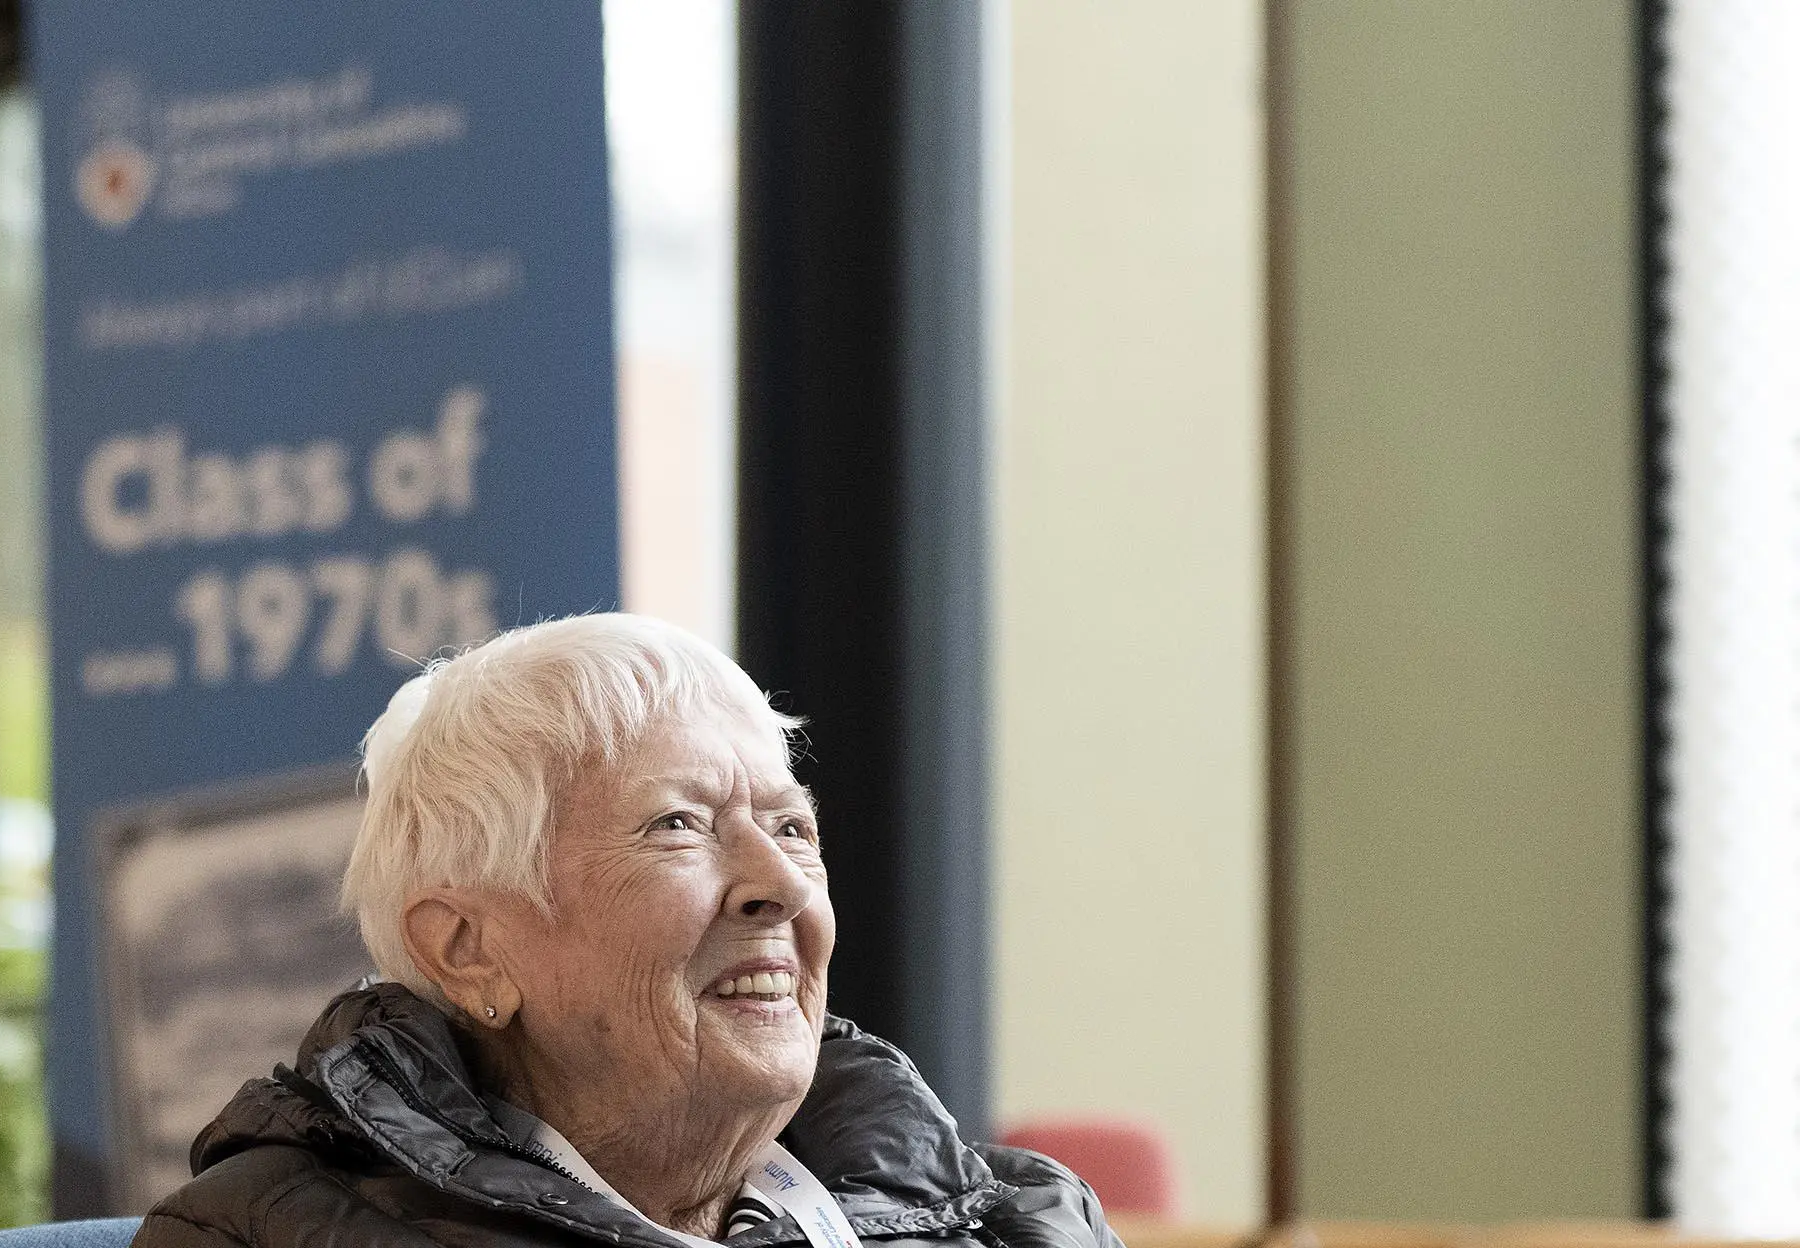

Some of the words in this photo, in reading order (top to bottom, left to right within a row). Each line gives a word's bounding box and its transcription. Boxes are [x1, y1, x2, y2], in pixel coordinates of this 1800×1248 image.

[81, 427, 352, 555] Class
[370, 387, 484, 522] of
[764, 1160, 799, 1191] Alumni
